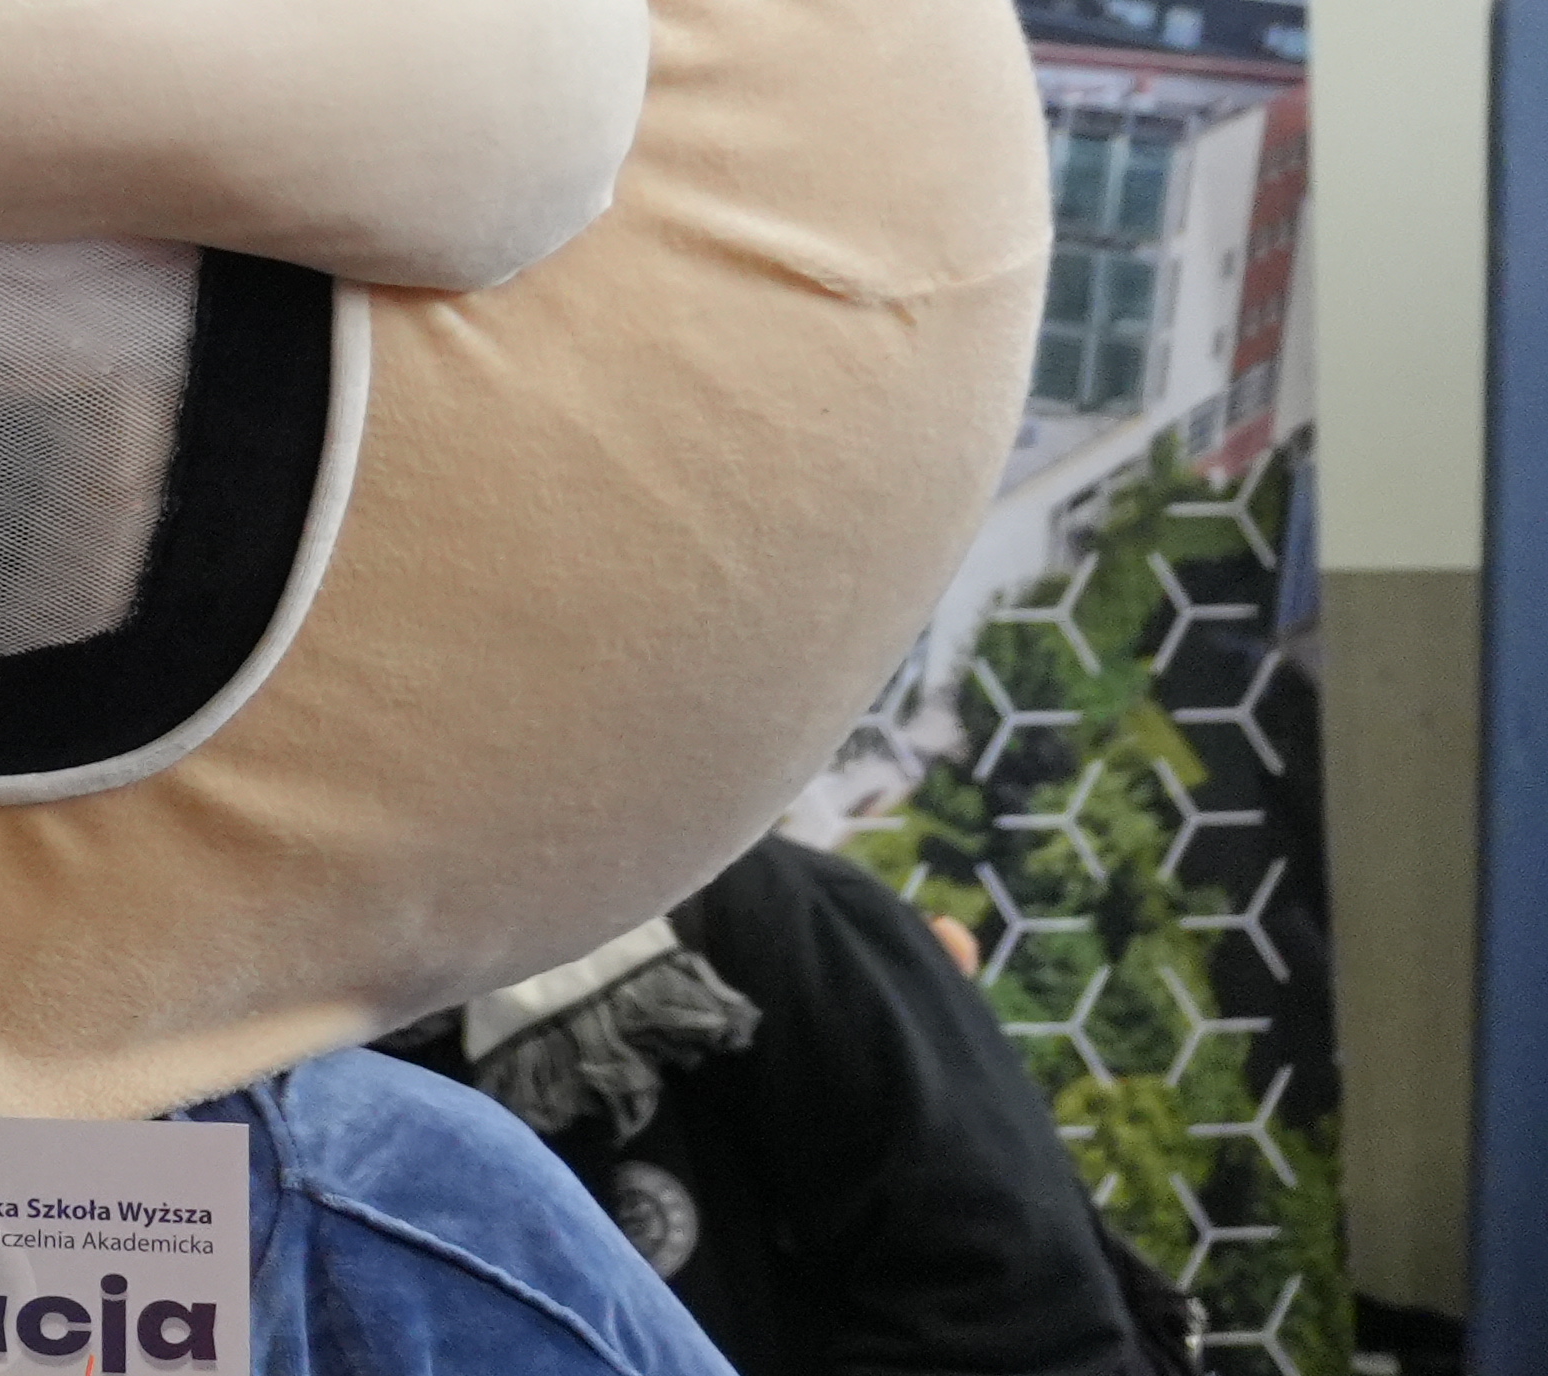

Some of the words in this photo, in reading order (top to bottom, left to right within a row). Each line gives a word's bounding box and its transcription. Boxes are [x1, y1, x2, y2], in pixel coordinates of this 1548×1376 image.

[26, 1196, 112, 1224] Szkoła
[117, 1200, 213, 1233] Wyższa
[83, 1230, 215, 1256] Akademicka
